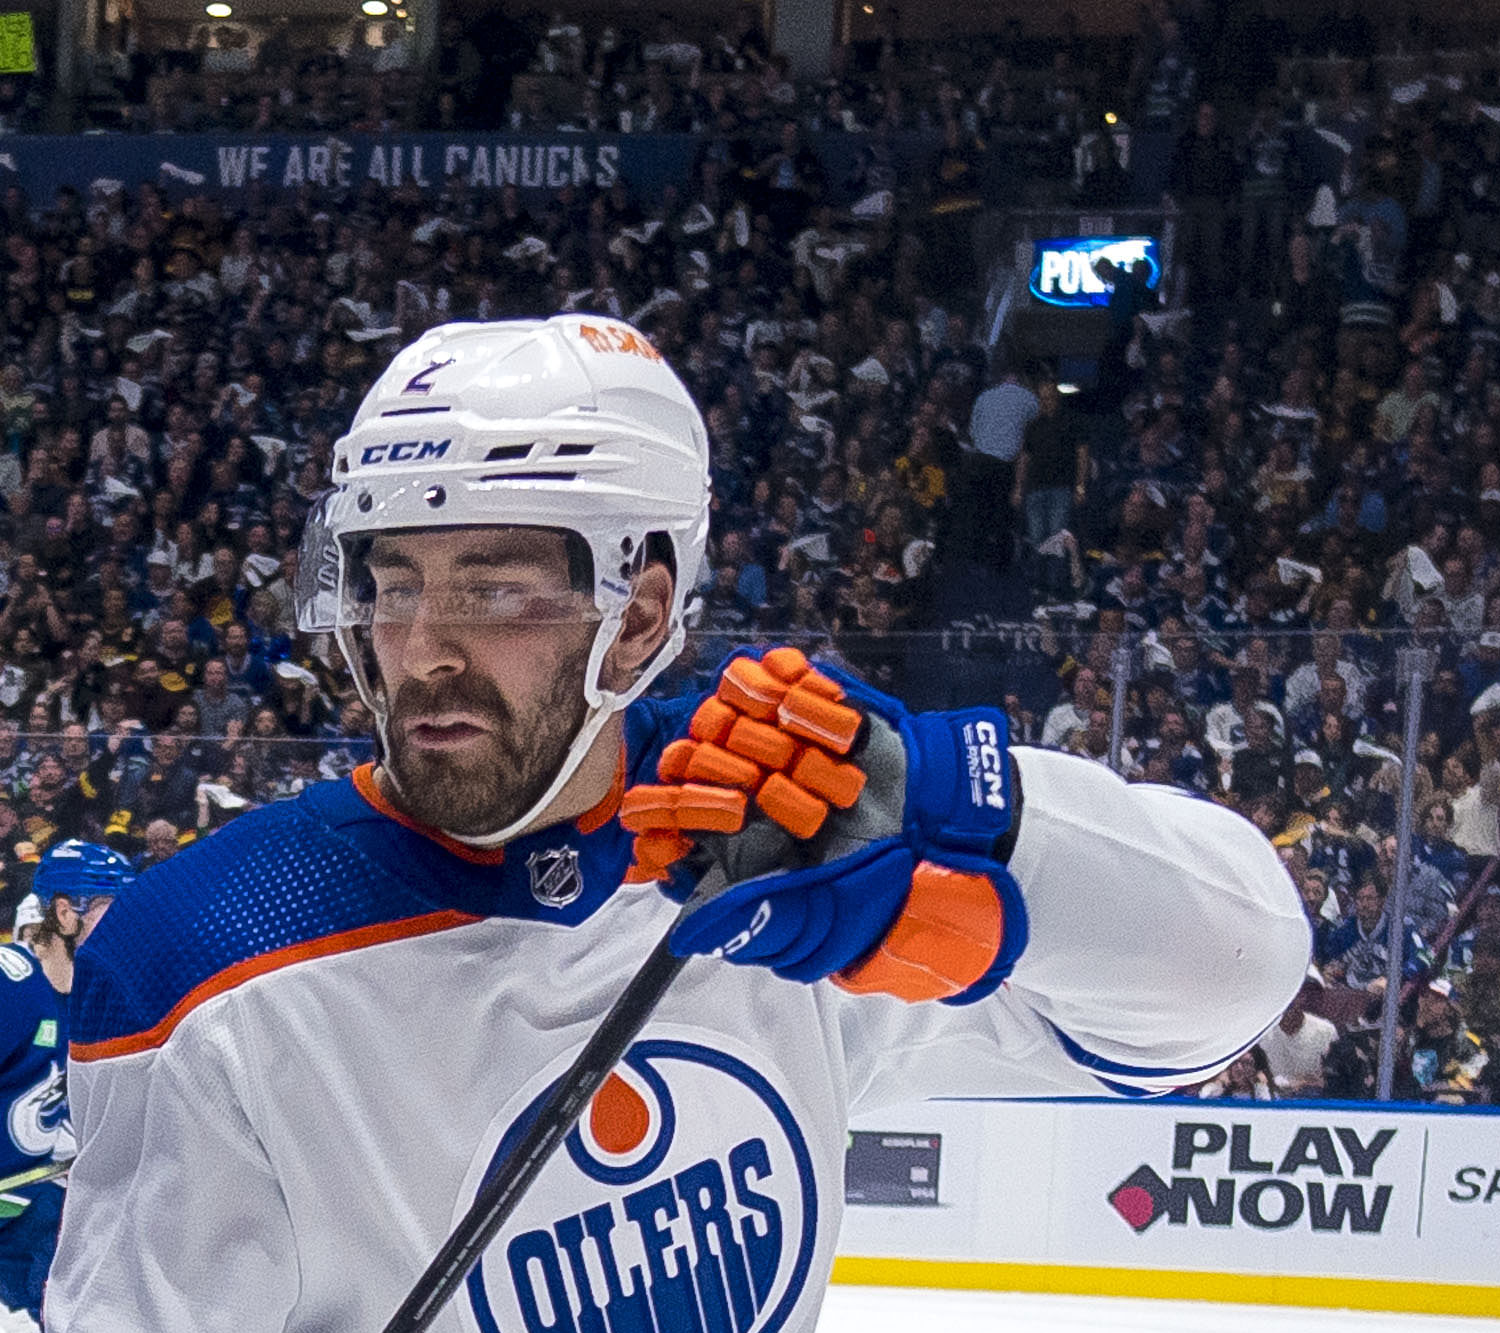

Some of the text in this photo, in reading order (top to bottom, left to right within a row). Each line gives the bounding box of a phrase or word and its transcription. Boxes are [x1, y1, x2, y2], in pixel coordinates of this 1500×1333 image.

[402, 360, 452, 396] 2
[360, 439, 452, 465] CCM
[976, 721, 1006, 810] CCM
[1172, 1121, 1397, 1178] PLAY
[1166, 1177, 1393, 1233] NOW
